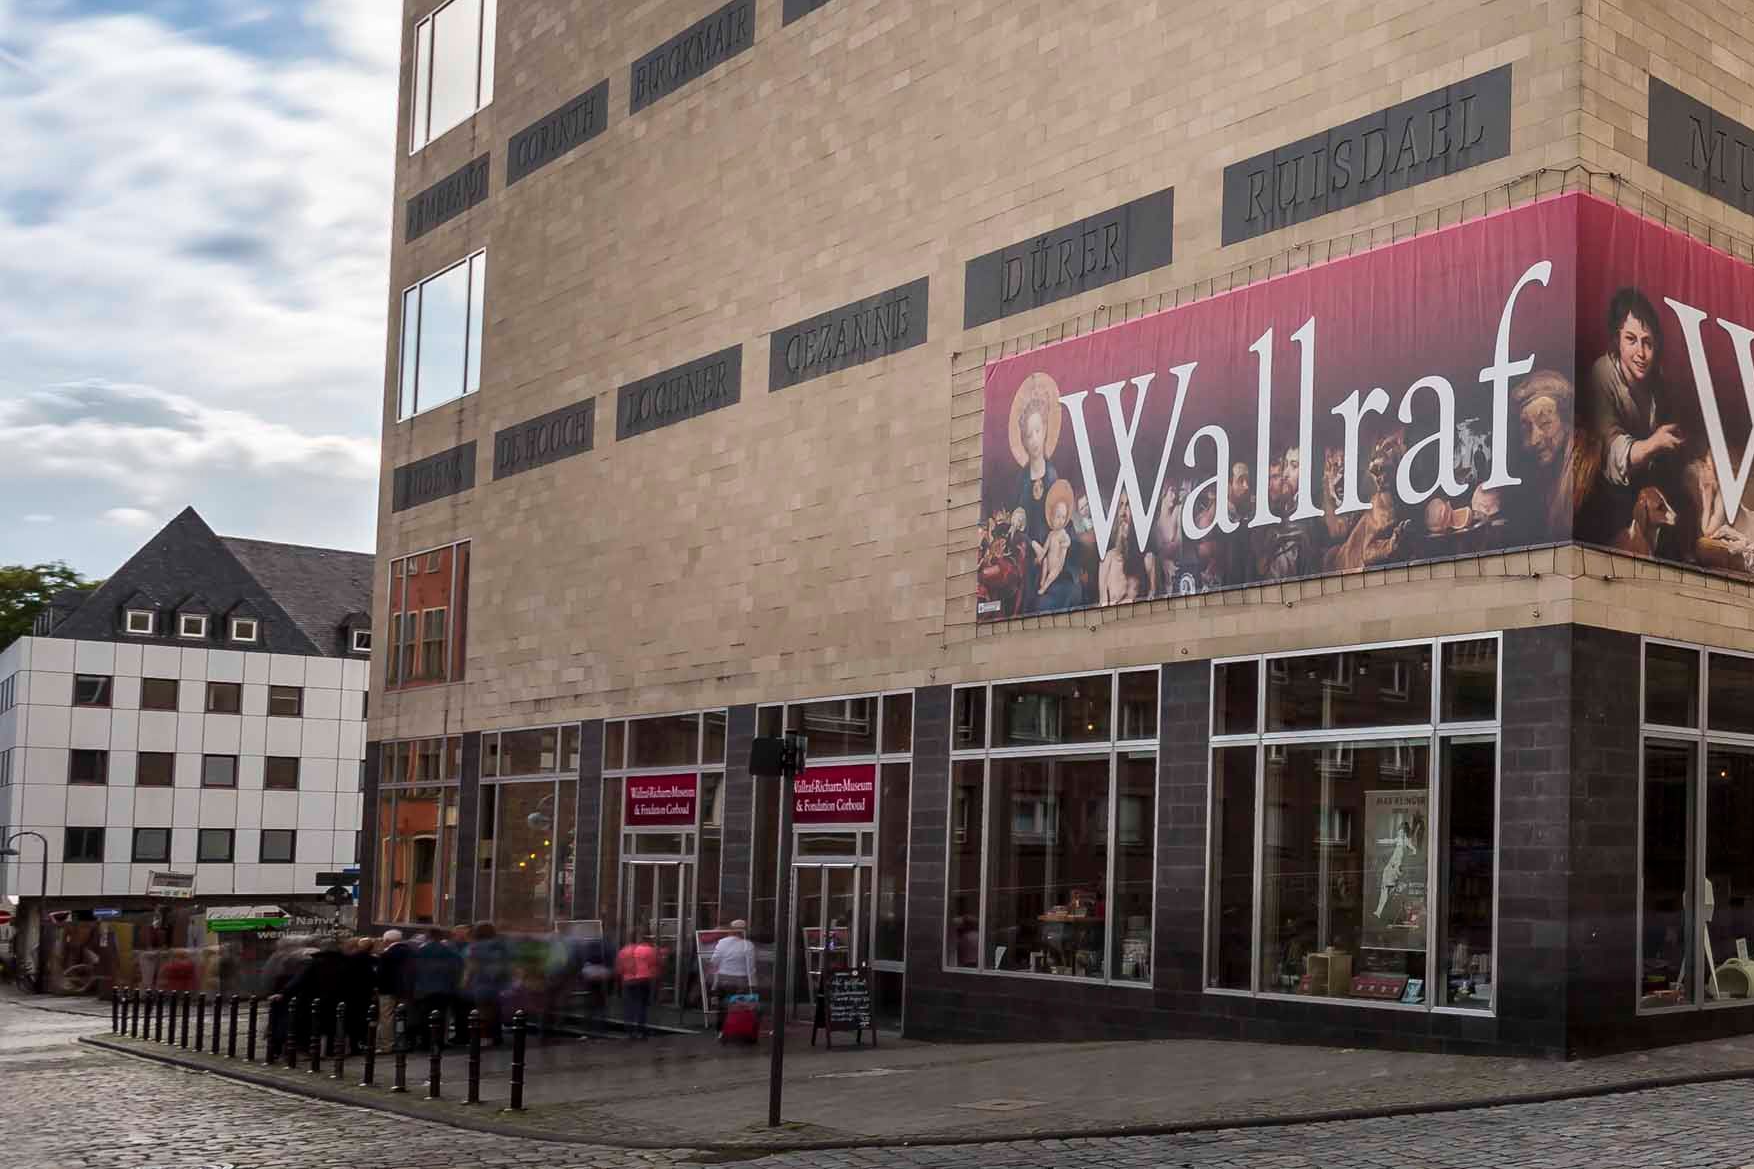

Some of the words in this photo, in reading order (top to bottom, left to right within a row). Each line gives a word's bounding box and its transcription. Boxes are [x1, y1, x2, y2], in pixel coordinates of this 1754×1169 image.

[635, 3, 748, 102] BURGKMAIR
[517, 93, 594, 166] CORINTH
[1244, 93, 1485, 222] RUISDAEL
[1003, 221, 1122, 303] DÜRER
[786, 295, 911, 374] CEZANNE
[624, 360, 728, 428] LOCHNER
[1059, 260, 1552, 561] Wallraf
